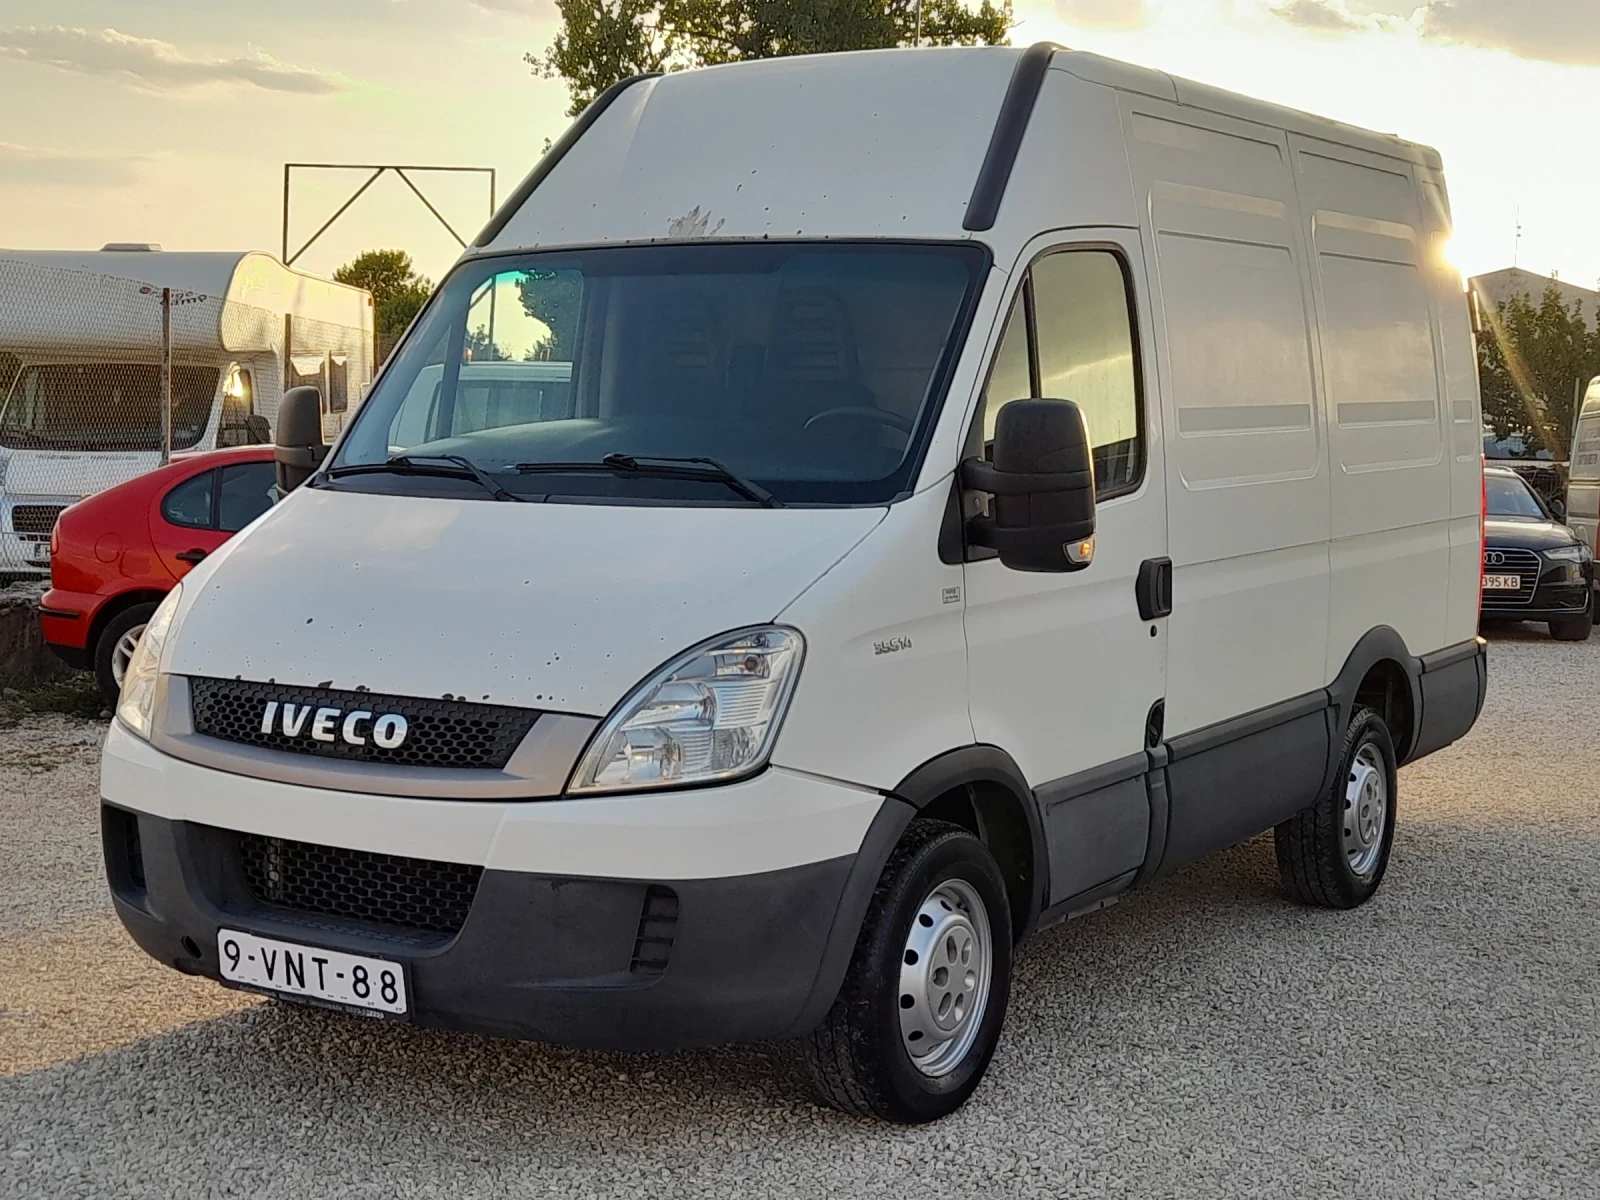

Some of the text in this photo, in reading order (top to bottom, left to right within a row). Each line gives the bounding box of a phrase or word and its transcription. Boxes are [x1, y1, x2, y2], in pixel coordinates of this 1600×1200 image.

[1503, 576, 1518, 588] KB
[260, 700, 409, 749] IVECO
[223, 939, 399, 1005] 9-VNT-88
